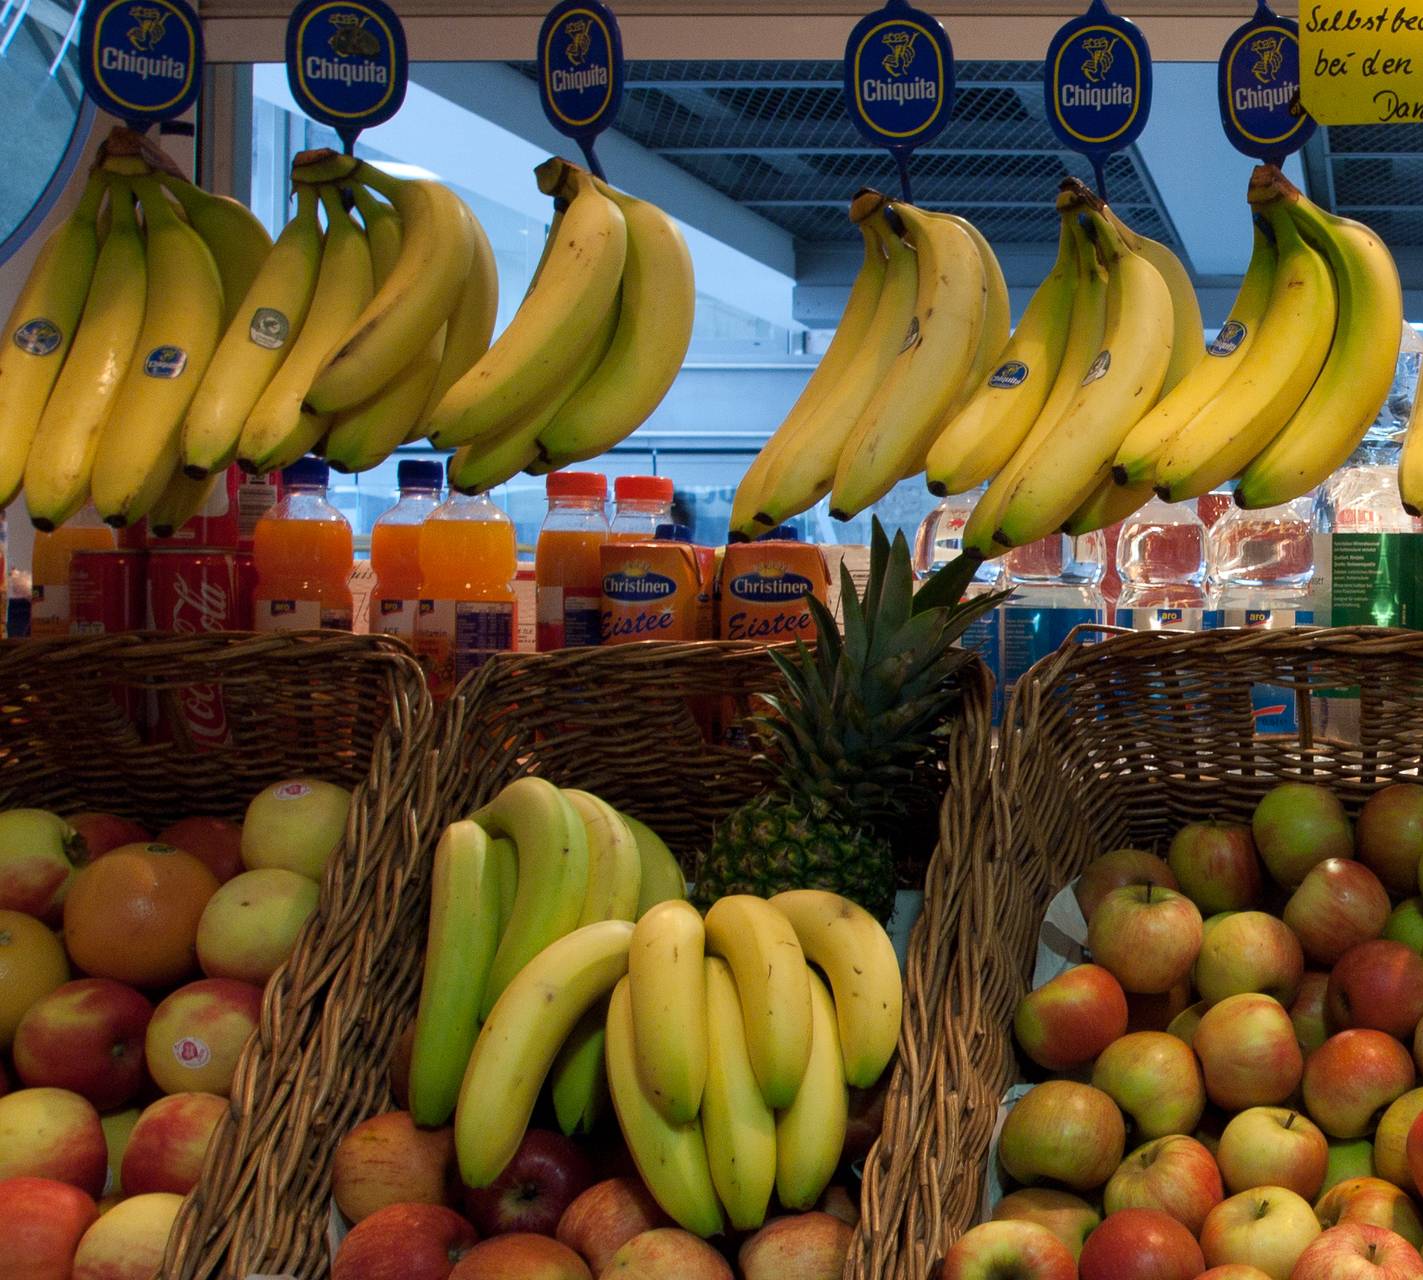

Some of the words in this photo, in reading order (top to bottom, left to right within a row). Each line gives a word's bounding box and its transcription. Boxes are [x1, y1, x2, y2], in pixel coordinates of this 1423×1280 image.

[102, 47, 185, 81] Chiquita
[305, 56, 388, 86] Chiquita
[1314, 48, 1355, 77] bei
[1362, 49, 1413, 77] den
[552, 64, 608, 96] Chiquita
[863, 78, 936, 103] Chiquita
[1061, 83, 1133, 109] Chiquita
[1236, 81, 1298, 111] Chiquit
[603, 575, 669, 596] Christinen
[735, 575, 808, 596] Christinen
[600, 610, 674, 641] Eistee
[729, 611, 811, 641] Eistee
[1161, 612, 1177, 621] aro
[1249, 612, 1265, 622] aro
